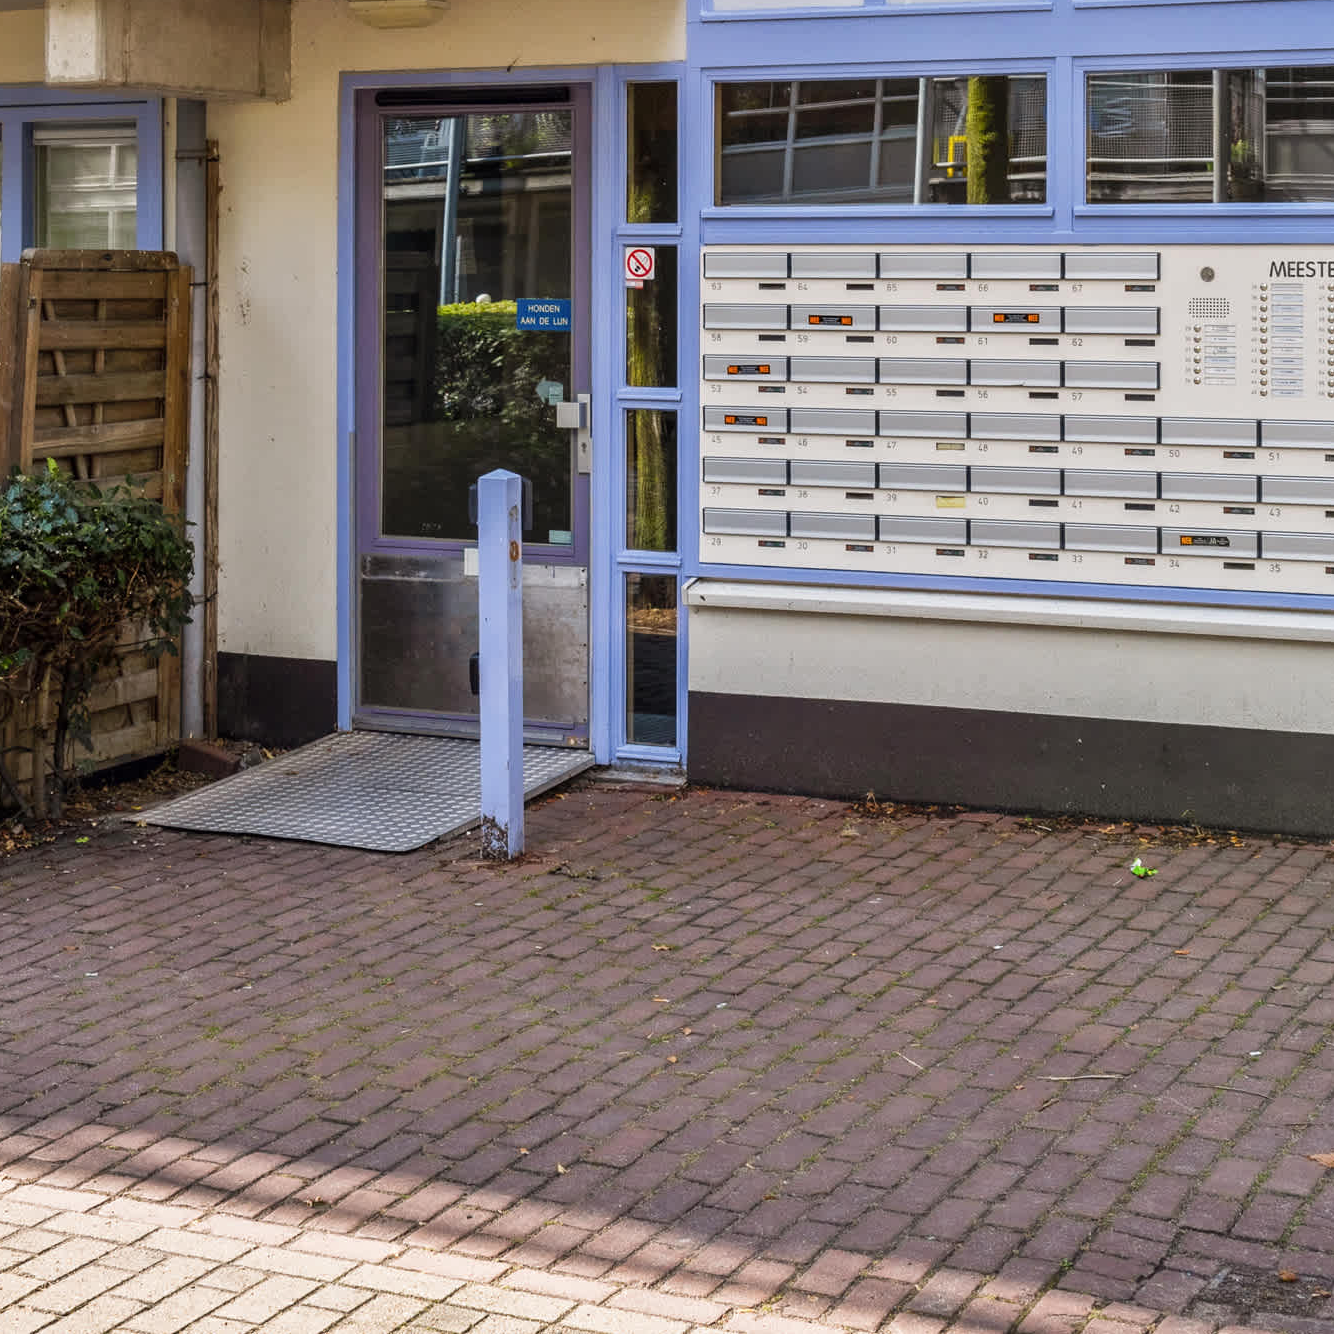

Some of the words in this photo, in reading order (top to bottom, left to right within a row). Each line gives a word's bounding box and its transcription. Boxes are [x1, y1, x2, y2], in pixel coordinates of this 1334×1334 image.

[527, 304, 560, 313] HONDEN
[520, 316, 536, 325] AAN
[538, 316, 549, 326] DE
